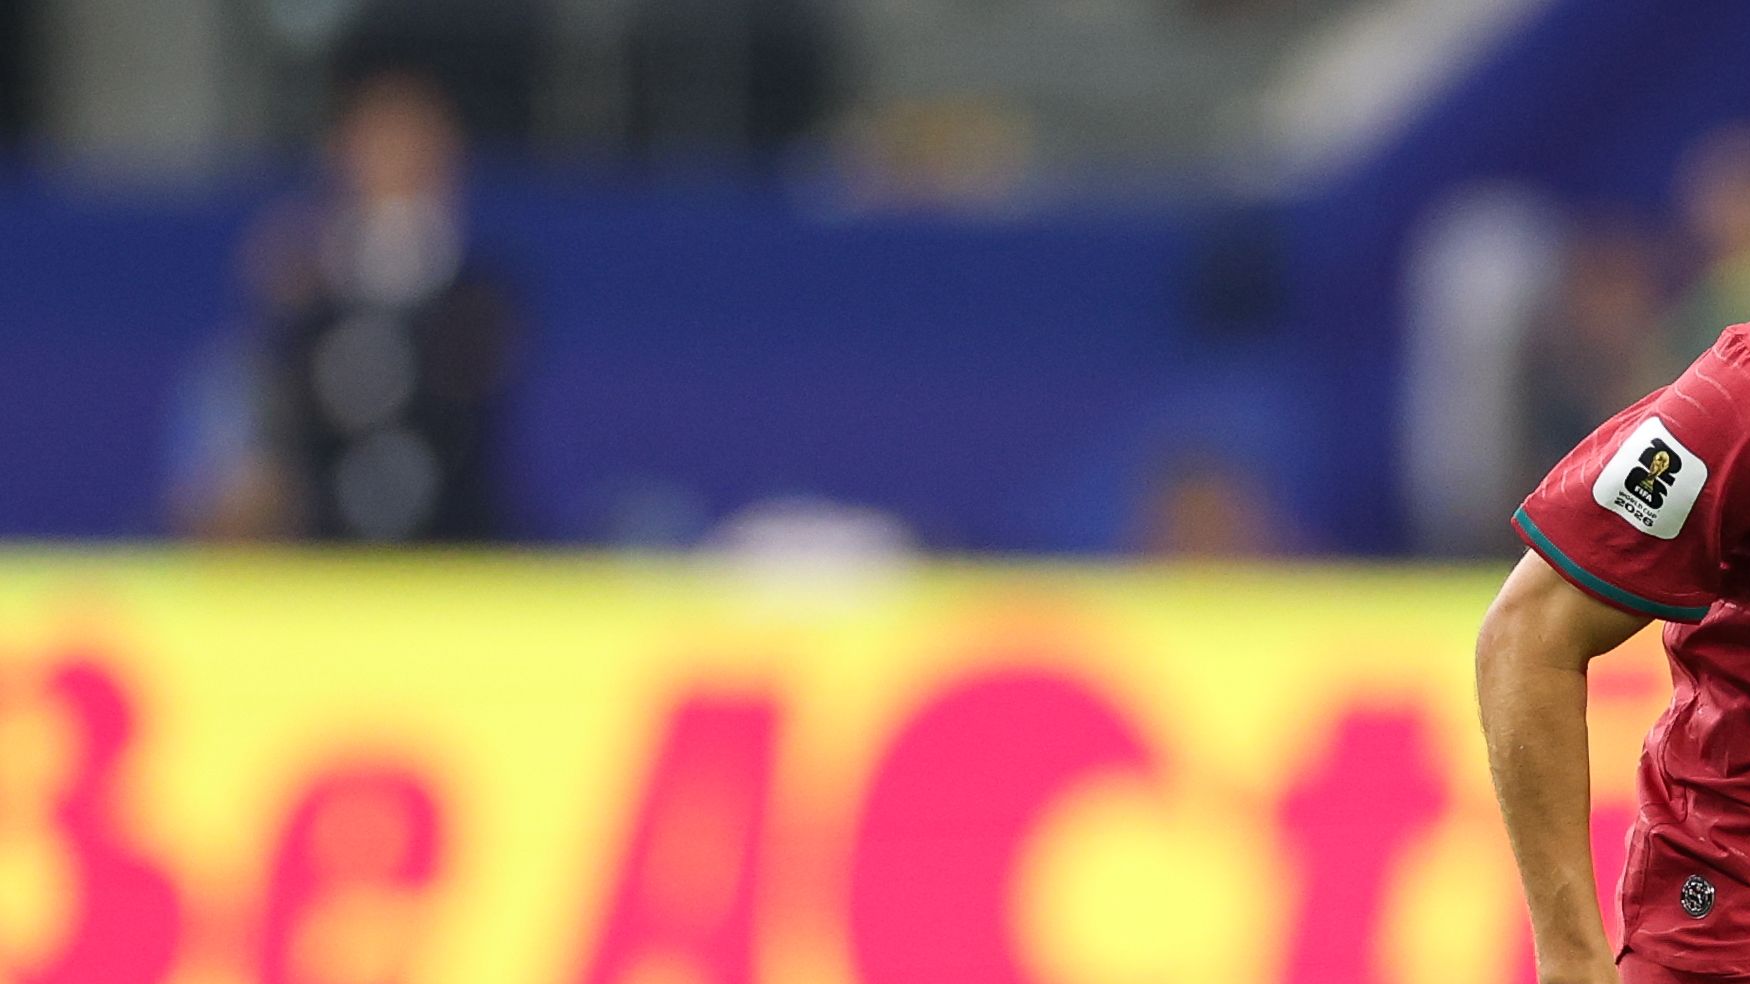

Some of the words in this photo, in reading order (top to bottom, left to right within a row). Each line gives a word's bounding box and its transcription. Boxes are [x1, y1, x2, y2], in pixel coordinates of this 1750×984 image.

[1618, 491, 1643, 509] WORLD
[1643, 507, 1658, 519] CUP
[1634, 485, 1652, 502] FIFA
[1614, 497, 1654, 527] 2026
